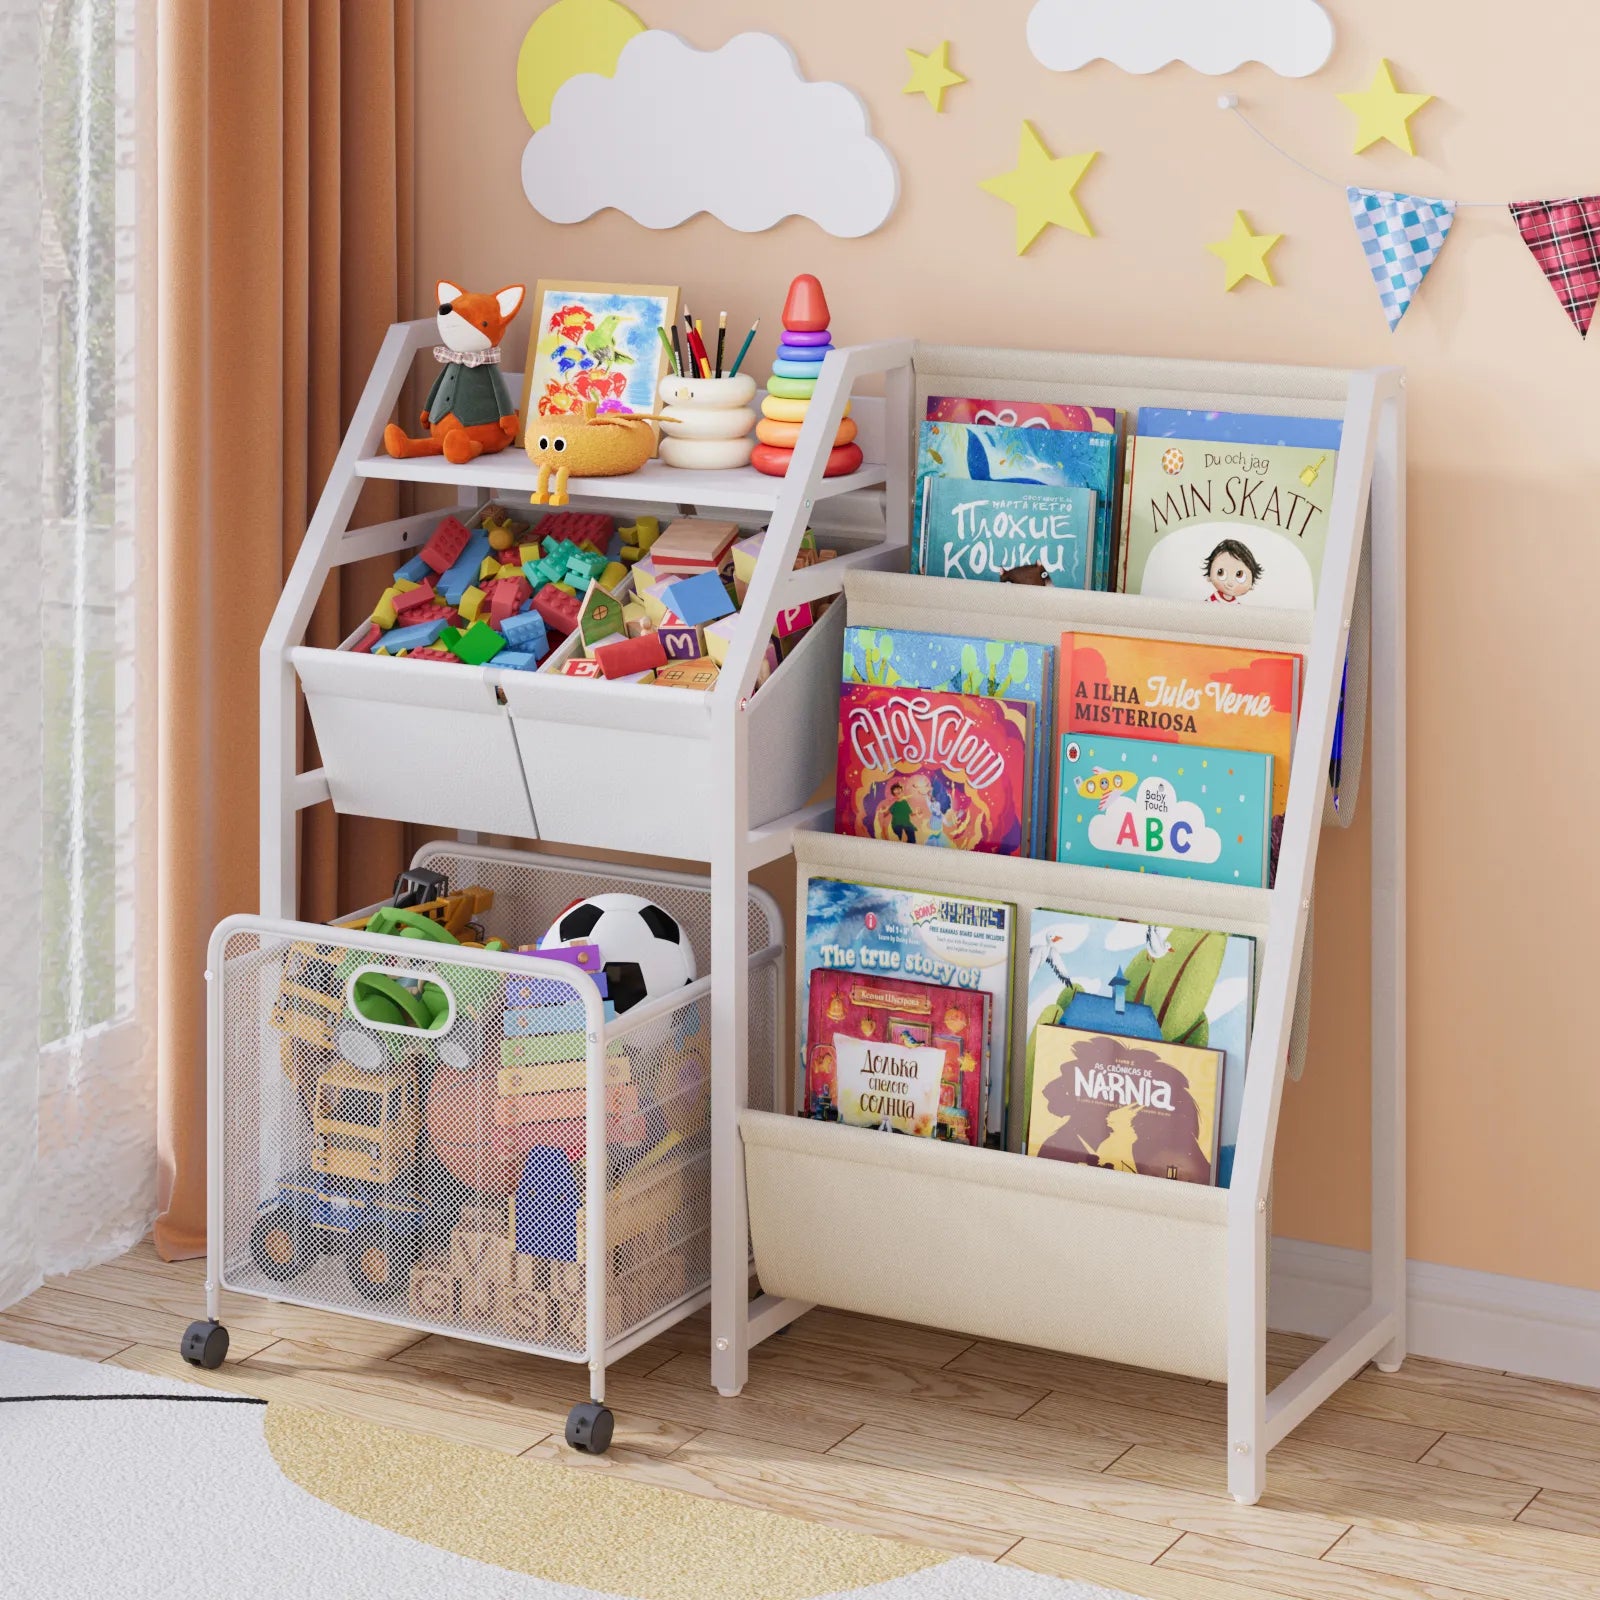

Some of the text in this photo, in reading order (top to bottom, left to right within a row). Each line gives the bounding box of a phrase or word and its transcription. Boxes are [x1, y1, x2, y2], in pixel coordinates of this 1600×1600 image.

[1204, 452, 1269, 475] Du och jag
[992, 500, 1072, 512] МАРТА КЕТРО
[1151, 476, 1323, 538] MIN SKATT
[665, 633, 695, 657] M
[1075, 676, 1272, 717] A ILHA Jules Verne
[1075, 703, 1198, 734] MISTERIOSA
[1145, 790, 1166, 804] Baby
[1145, 801, 1168, 813] Touch
[913, 903, 937, 920] BONUS
[820, 944, 981, 990] The true story of
[860, 1049, 918, 1079] Долька
[1095, 1063, 1153, 1078] AS CRÔNICAS DE
[869, 1077, 908, 1095] спелого
[860, 1093, 915, 1121] солнца
